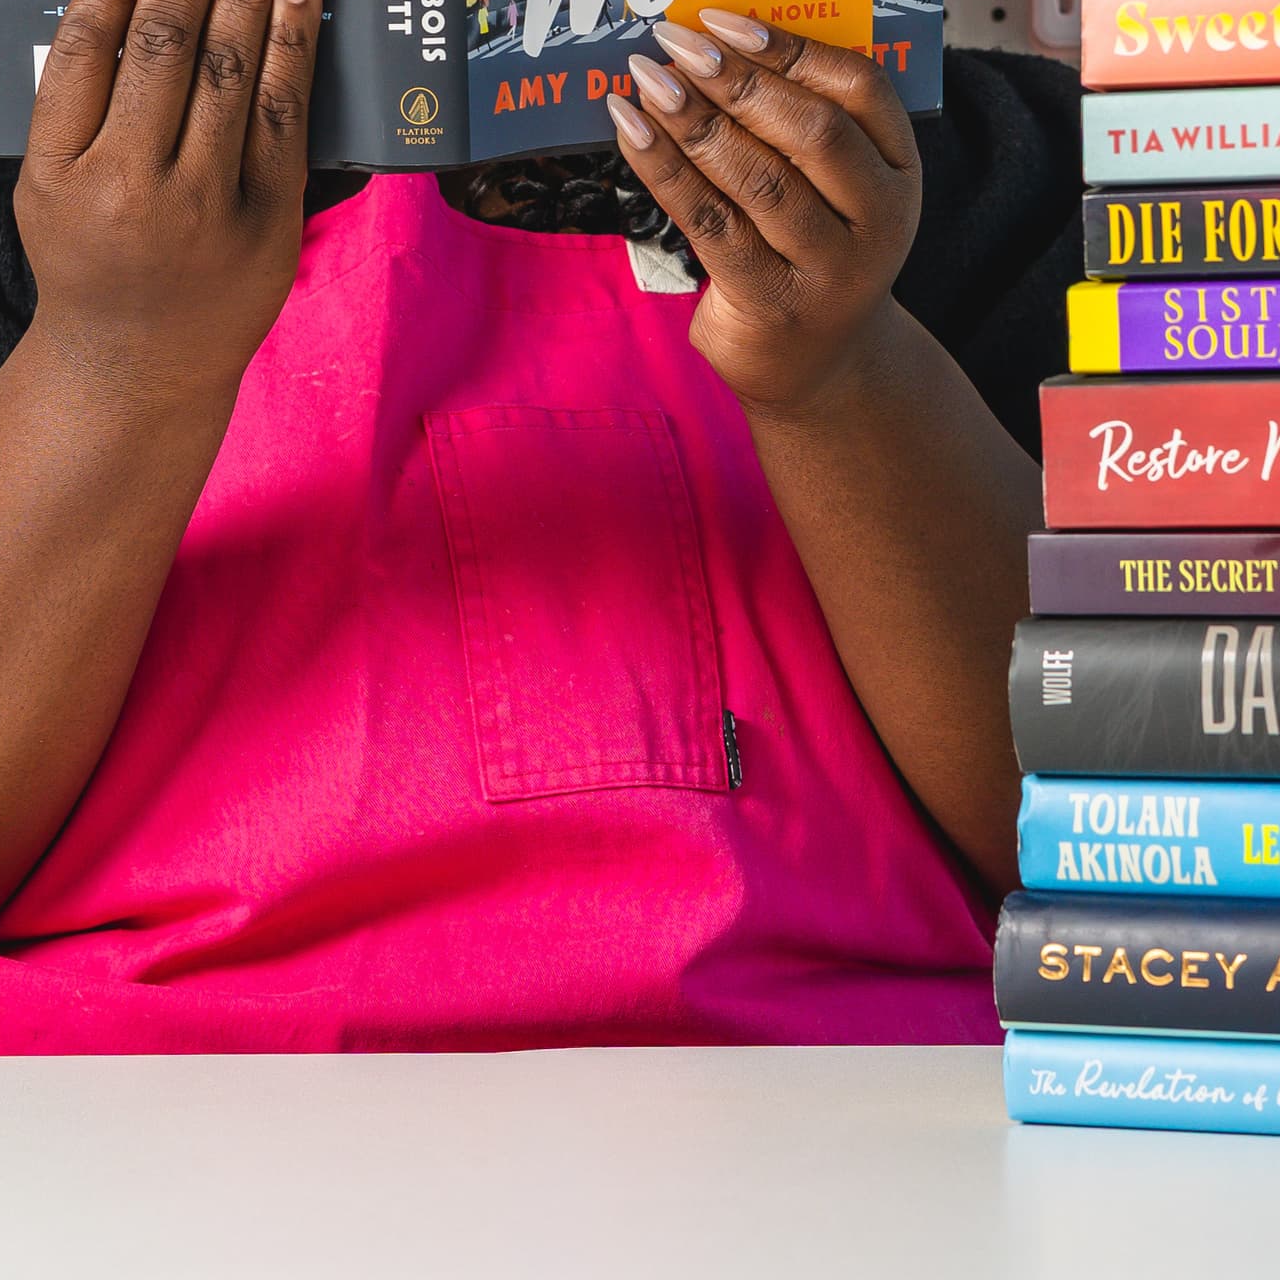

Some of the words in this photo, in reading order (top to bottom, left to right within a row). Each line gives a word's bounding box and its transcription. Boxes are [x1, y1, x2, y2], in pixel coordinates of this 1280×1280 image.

[770, 2, 841, 22] NOVEL
[494, 72, 568, 116] AMY
[396, 127, 444, 136] FLATIRON
[405, 136, 436, 145] BOOKS
[1107, 129, 1165, 155] TIA
[1107, 201, 1183, 266] DIE
[1088, 419, 1250, 492] Restore
[1119, 558, 1173, 594] THE
[1178, 558, 1279, 594] SECRET
[1042, 650, 1074, 705] WOLFE
[1069, 793, 1200, 837] TOLANI
[1056, 842, 1217, 886] AKINOLA
[1038, 943, 1247, 989] STACEY
[1028, 1068, 1067, 1098] The
[1074, 1061, 1236, 1106] Revelation
[1243, 1083, 1269, 1113] of
